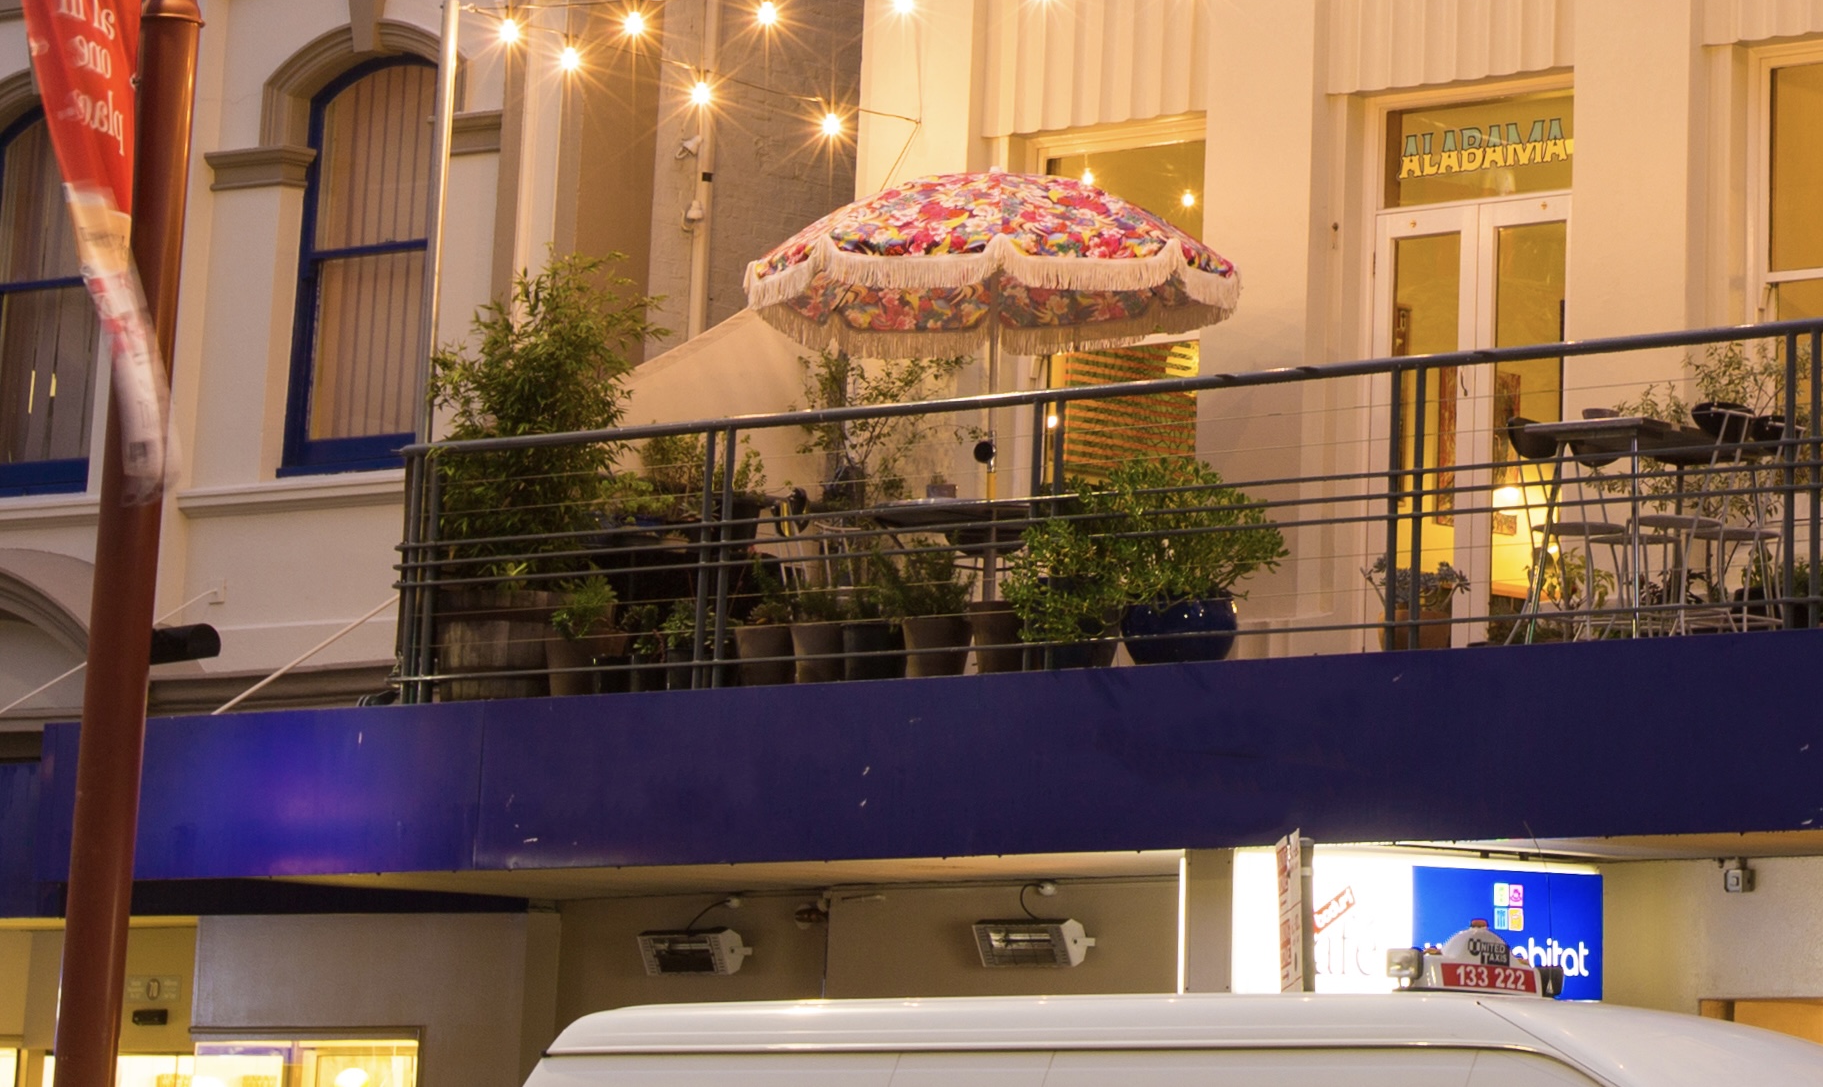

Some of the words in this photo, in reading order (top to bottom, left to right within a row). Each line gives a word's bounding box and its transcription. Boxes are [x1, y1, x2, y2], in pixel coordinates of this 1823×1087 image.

[1398, 117, 1568, 180] ALABAMA
[1455, 965, 1489, 987] 133
[1494, 967, 1527, 991] 222
